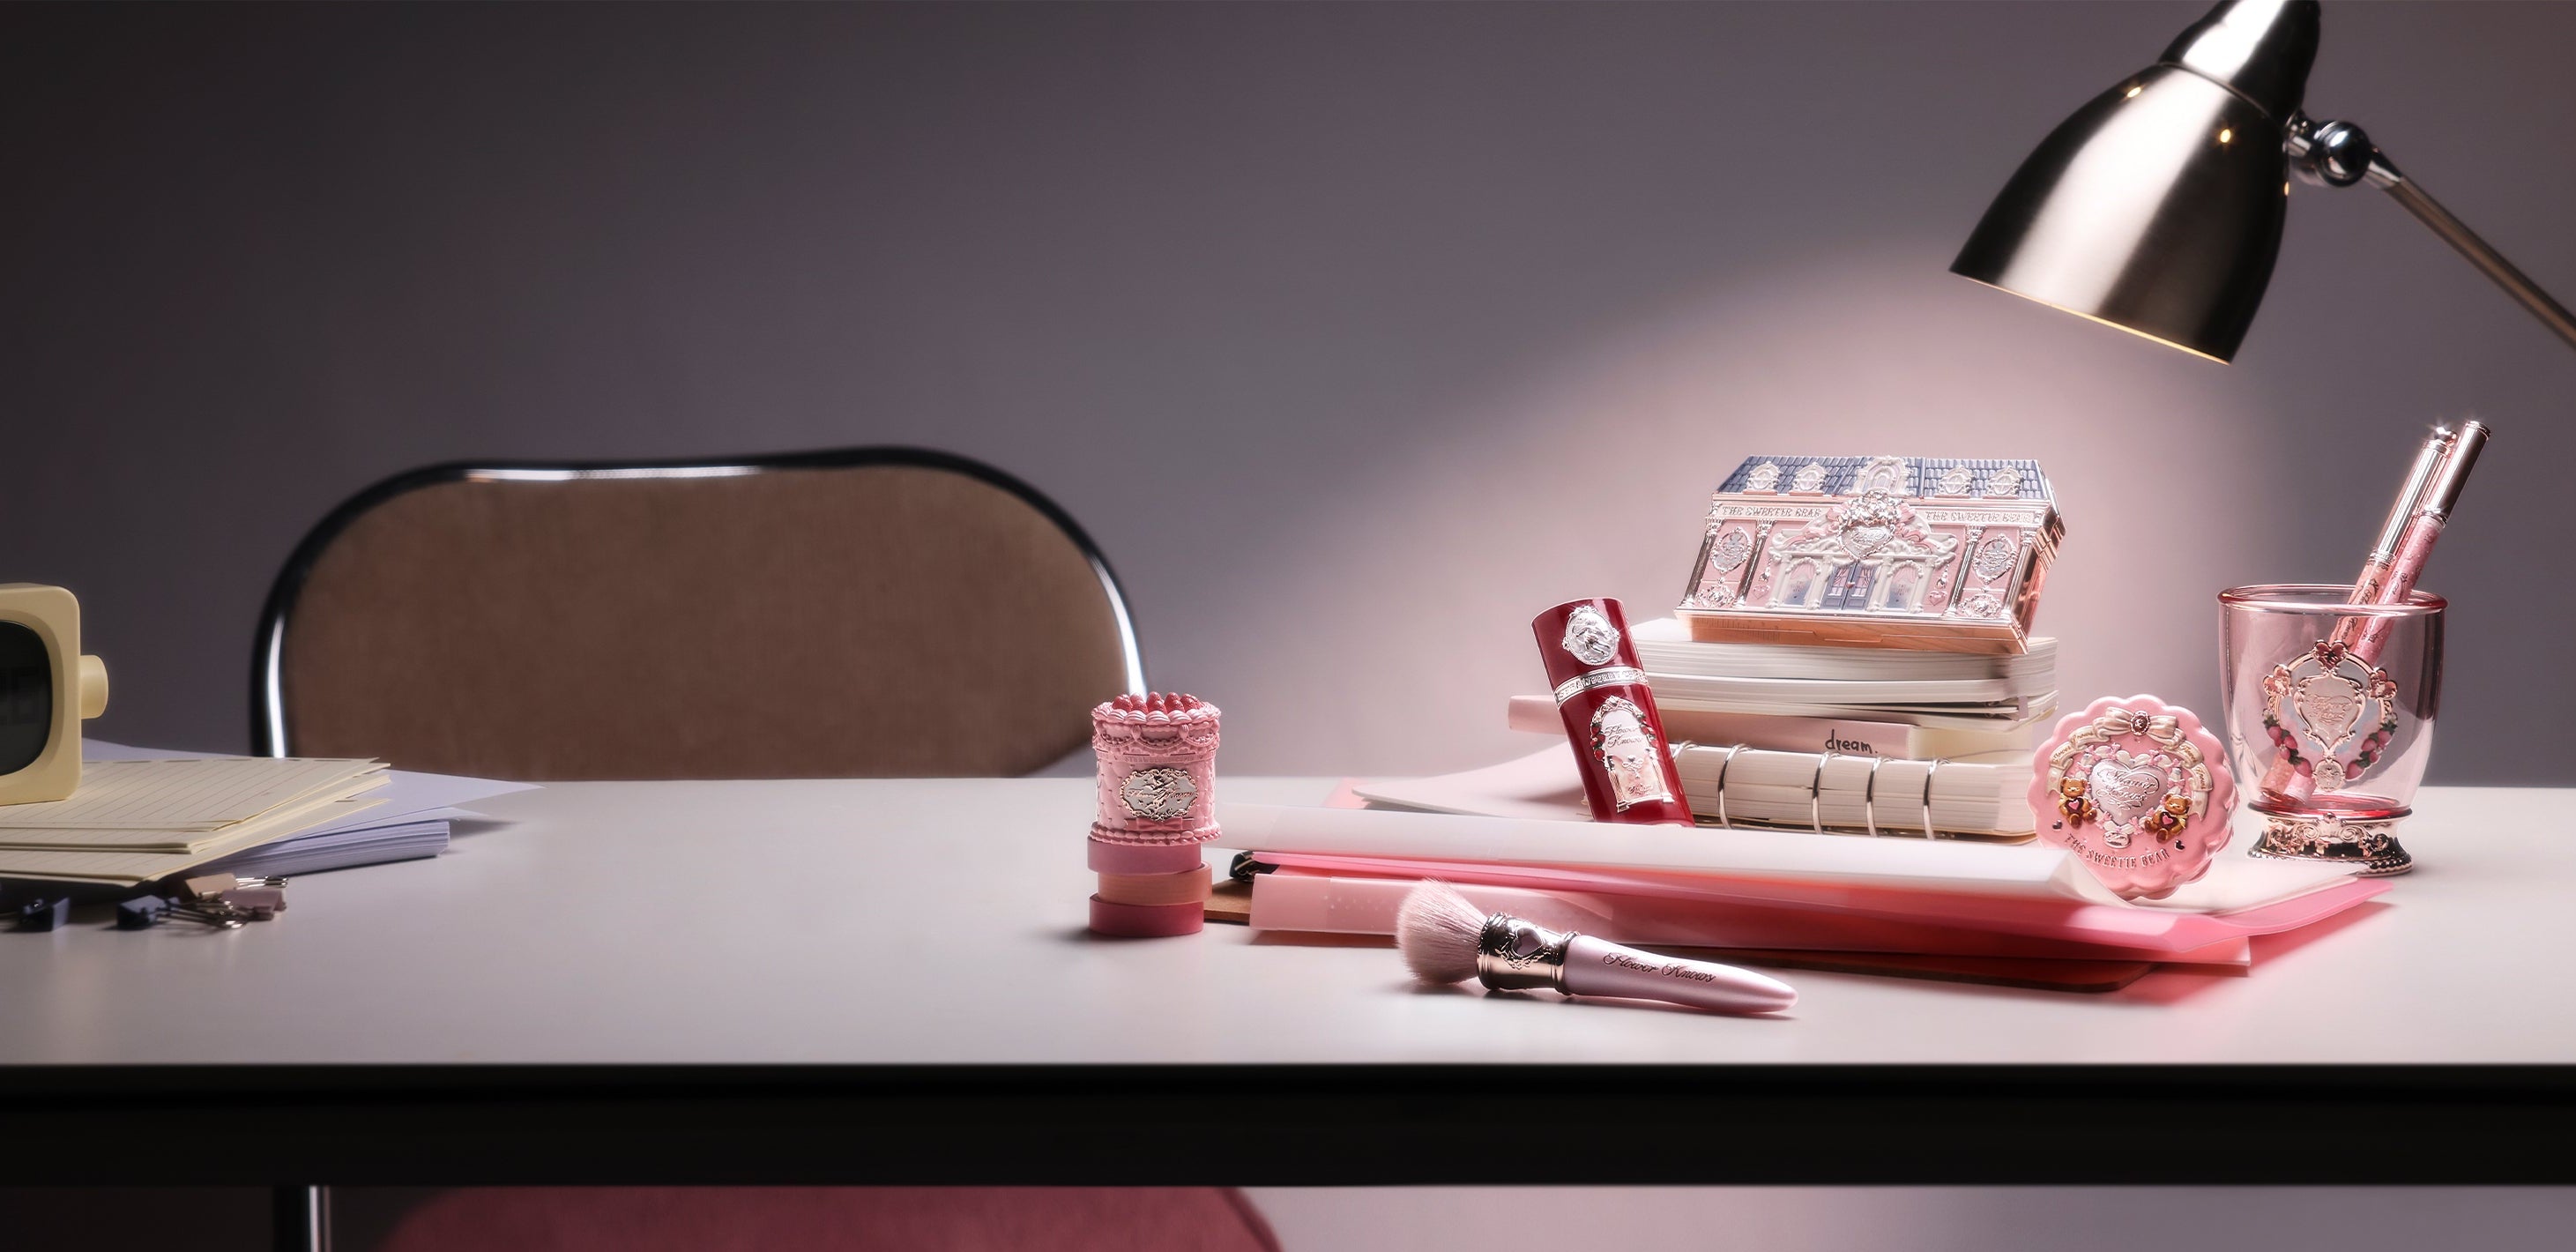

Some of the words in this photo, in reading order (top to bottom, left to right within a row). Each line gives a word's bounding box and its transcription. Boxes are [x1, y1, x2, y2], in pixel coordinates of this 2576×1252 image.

[1723, 506, 1744, 516] THE
[1925, 510, 1947, 520] THE
[1825, 728, 1878, 754] dream.
[2065, 833, 2086, 854] THE
[2086, 849, 2137, 868] SWEETIE
[2140, 847, 2170, 867] BEAR
[1603, 952, 1659, 973] Flower
[1661, 964, 1716, 983] Knows
